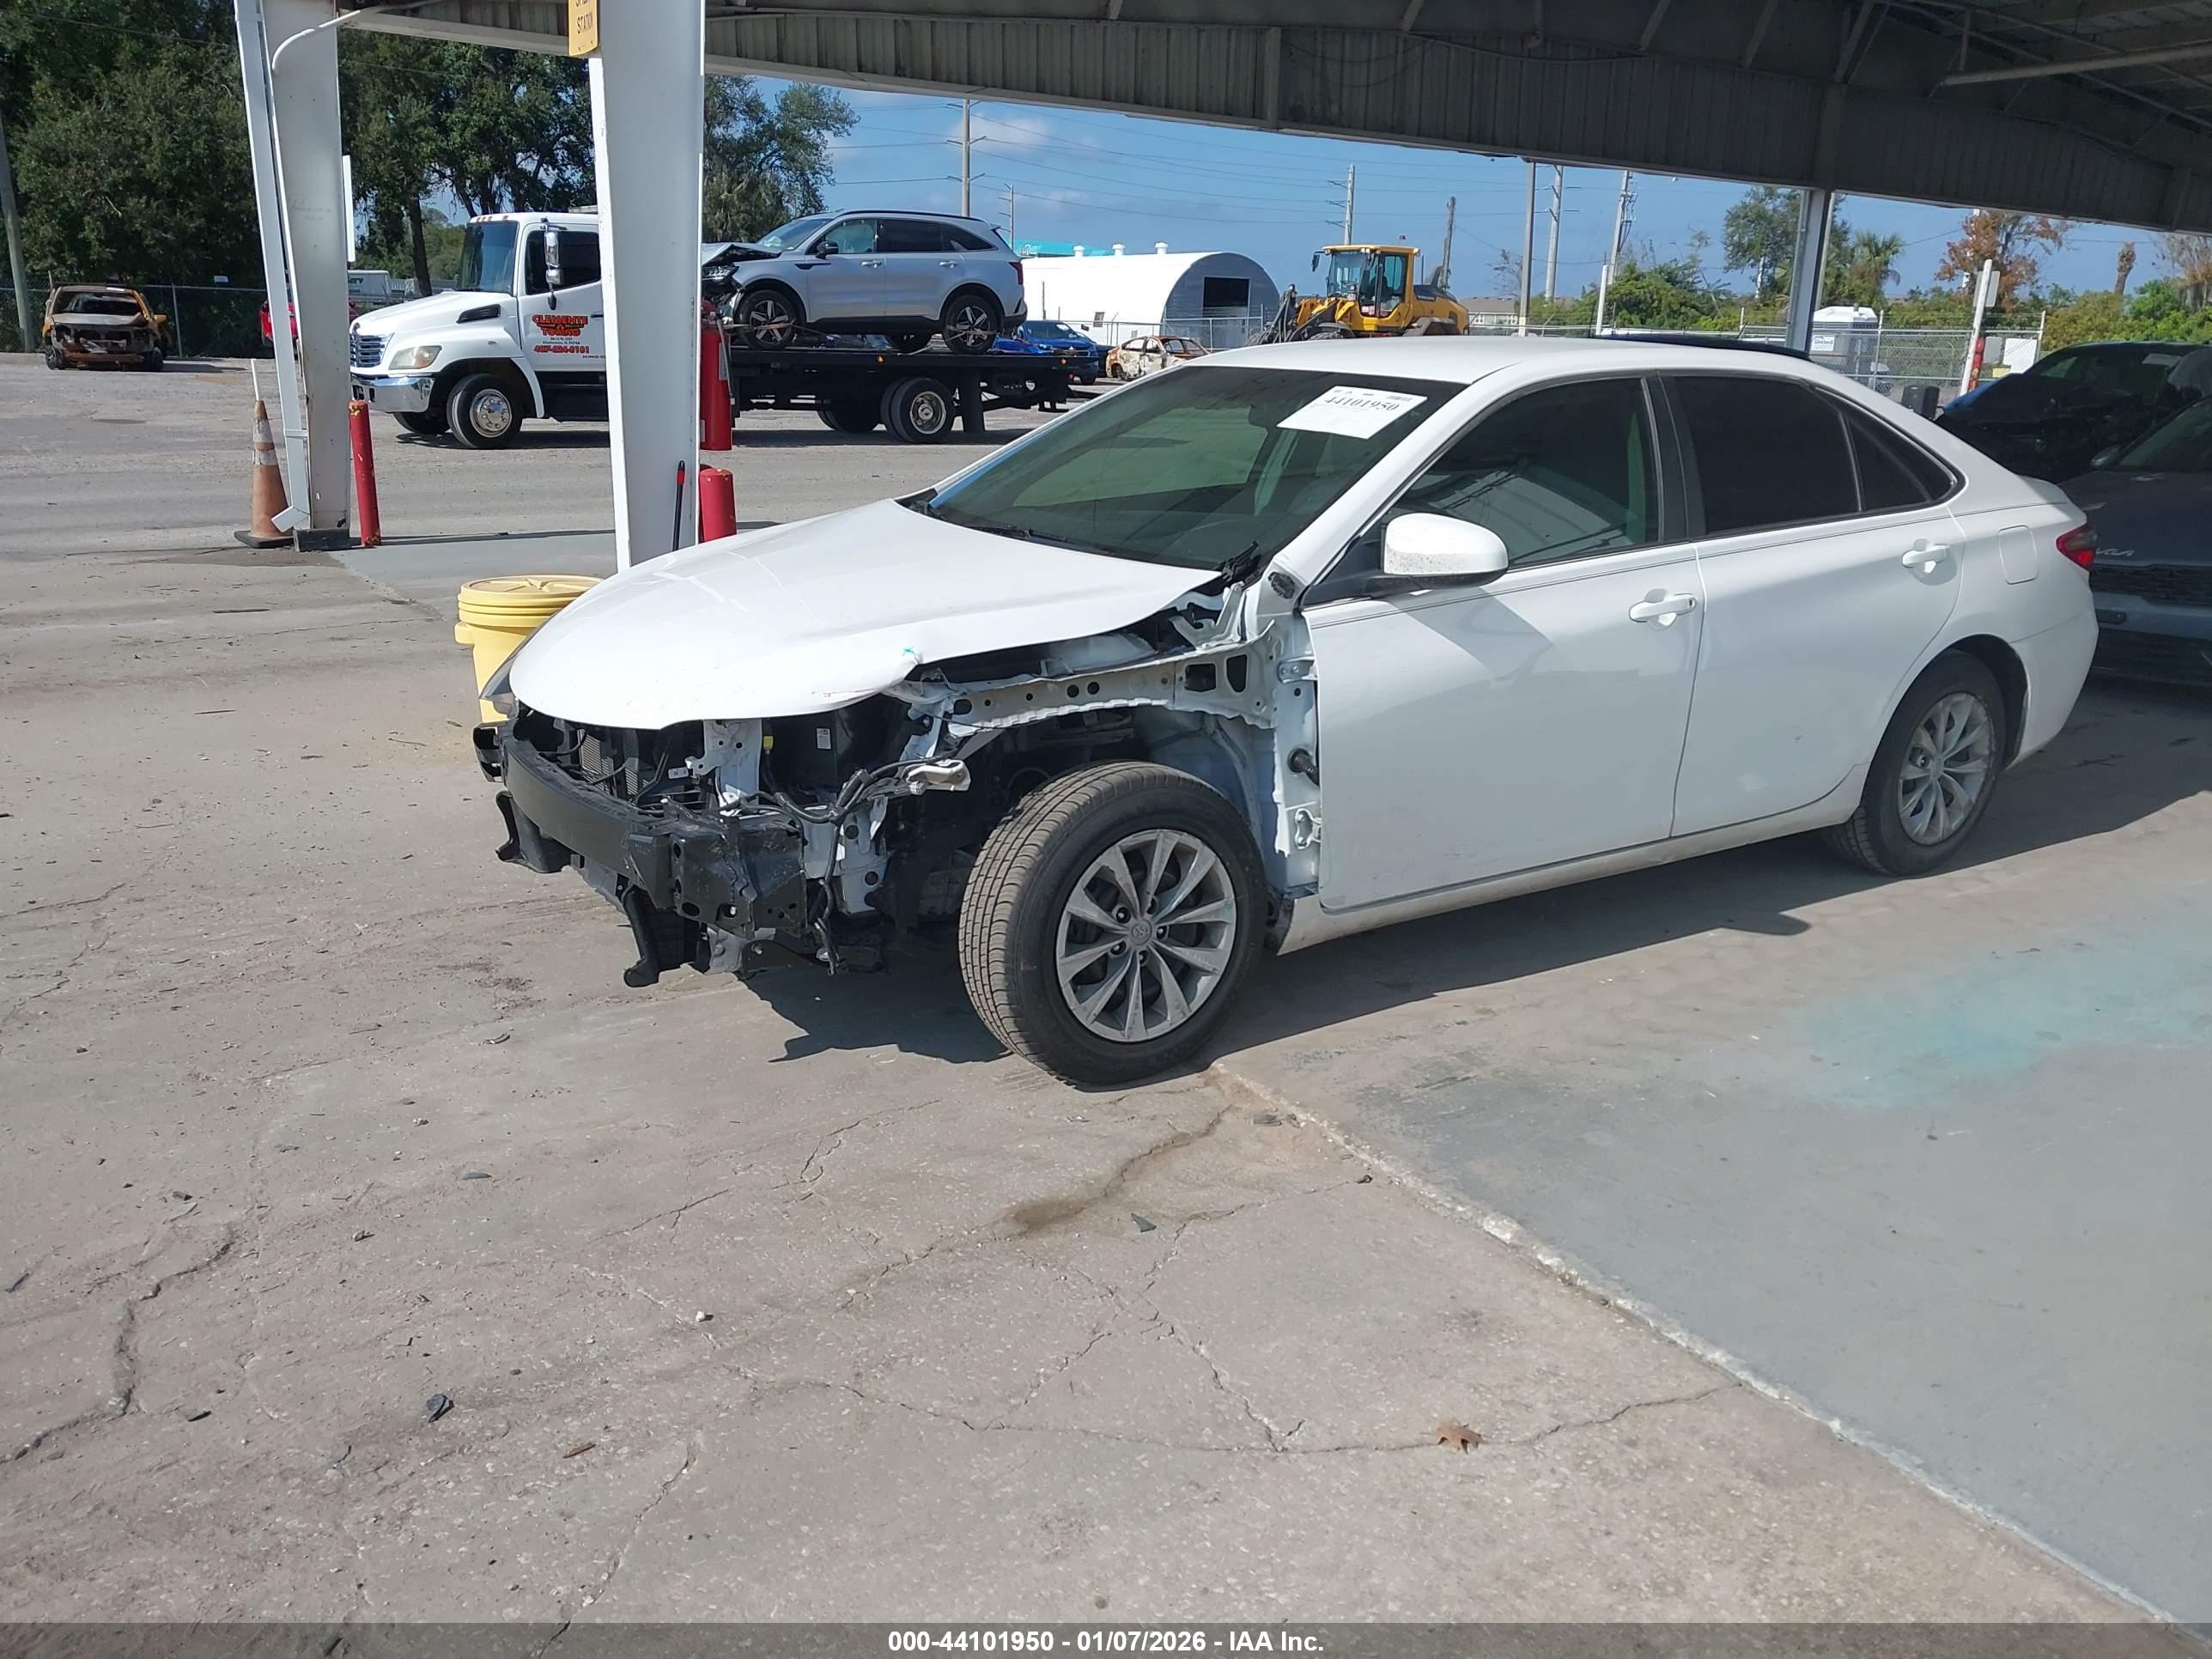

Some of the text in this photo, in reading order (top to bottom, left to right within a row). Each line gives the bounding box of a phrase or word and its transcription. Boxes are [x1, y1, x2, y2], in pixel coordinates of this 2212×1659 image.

[576, 11, 593, 34] STATION
[532, 314, 588, 325] CLEMENTE
[542, 327, 581, 336] TOWING
[1324, 396, 1400, 411] 44101950
